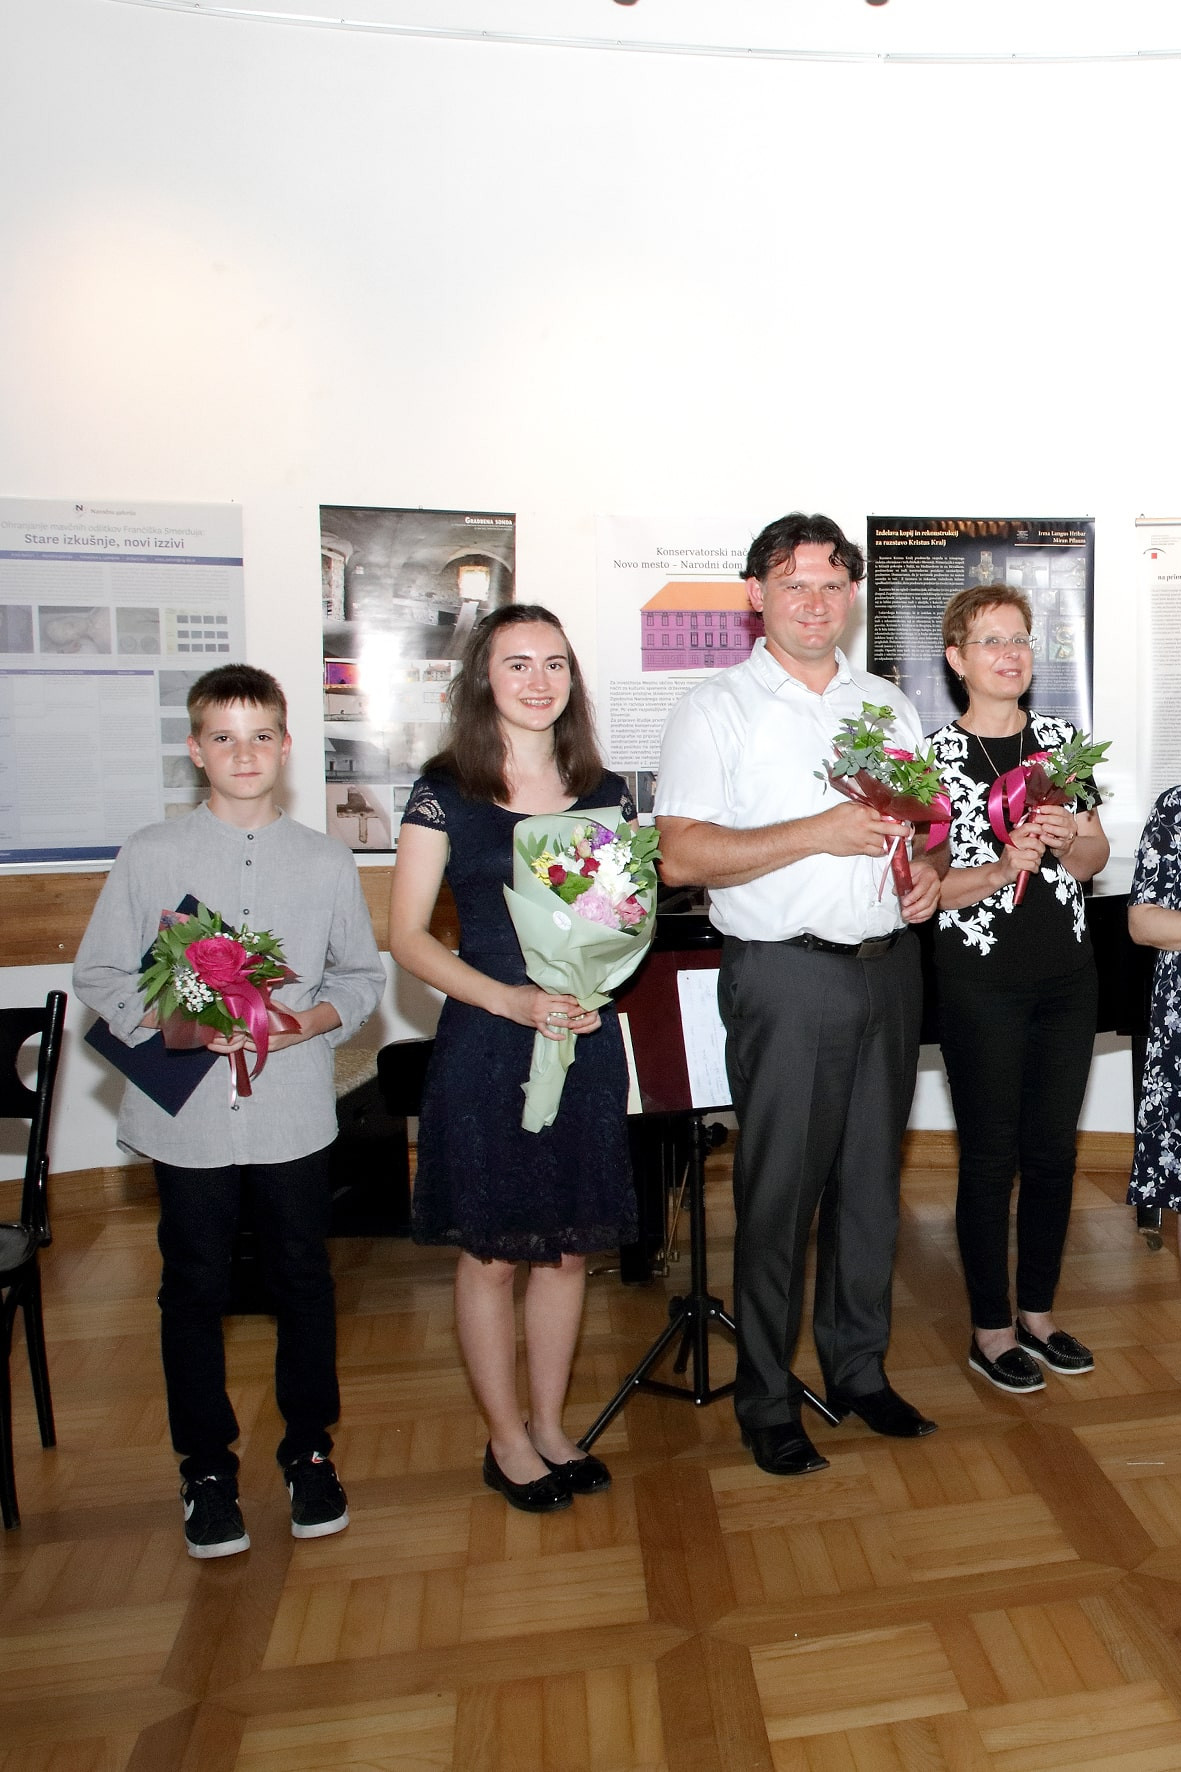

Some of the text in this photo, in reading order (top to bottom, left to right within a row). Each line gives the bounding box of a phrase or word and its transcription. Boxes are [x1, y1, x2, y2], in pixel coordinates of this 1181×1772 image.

[1, 521, 48, 532] Ohranjanje
[899, 529, 914, 537] kopij
[921, 530, 959, 538] rekonstrukcij
[24, 533, 185, 549] Stare izkušnje, novi izzivi
[930, 539, 947, 547] Kralj
[656, 547, 728, 557] Konservatorski
[613, 560, 639, 569] Novo
[641, 560, 670, 569] mesto
[680, 560, 720, 569] Narodni
[722, 560, 743, 569] dom
